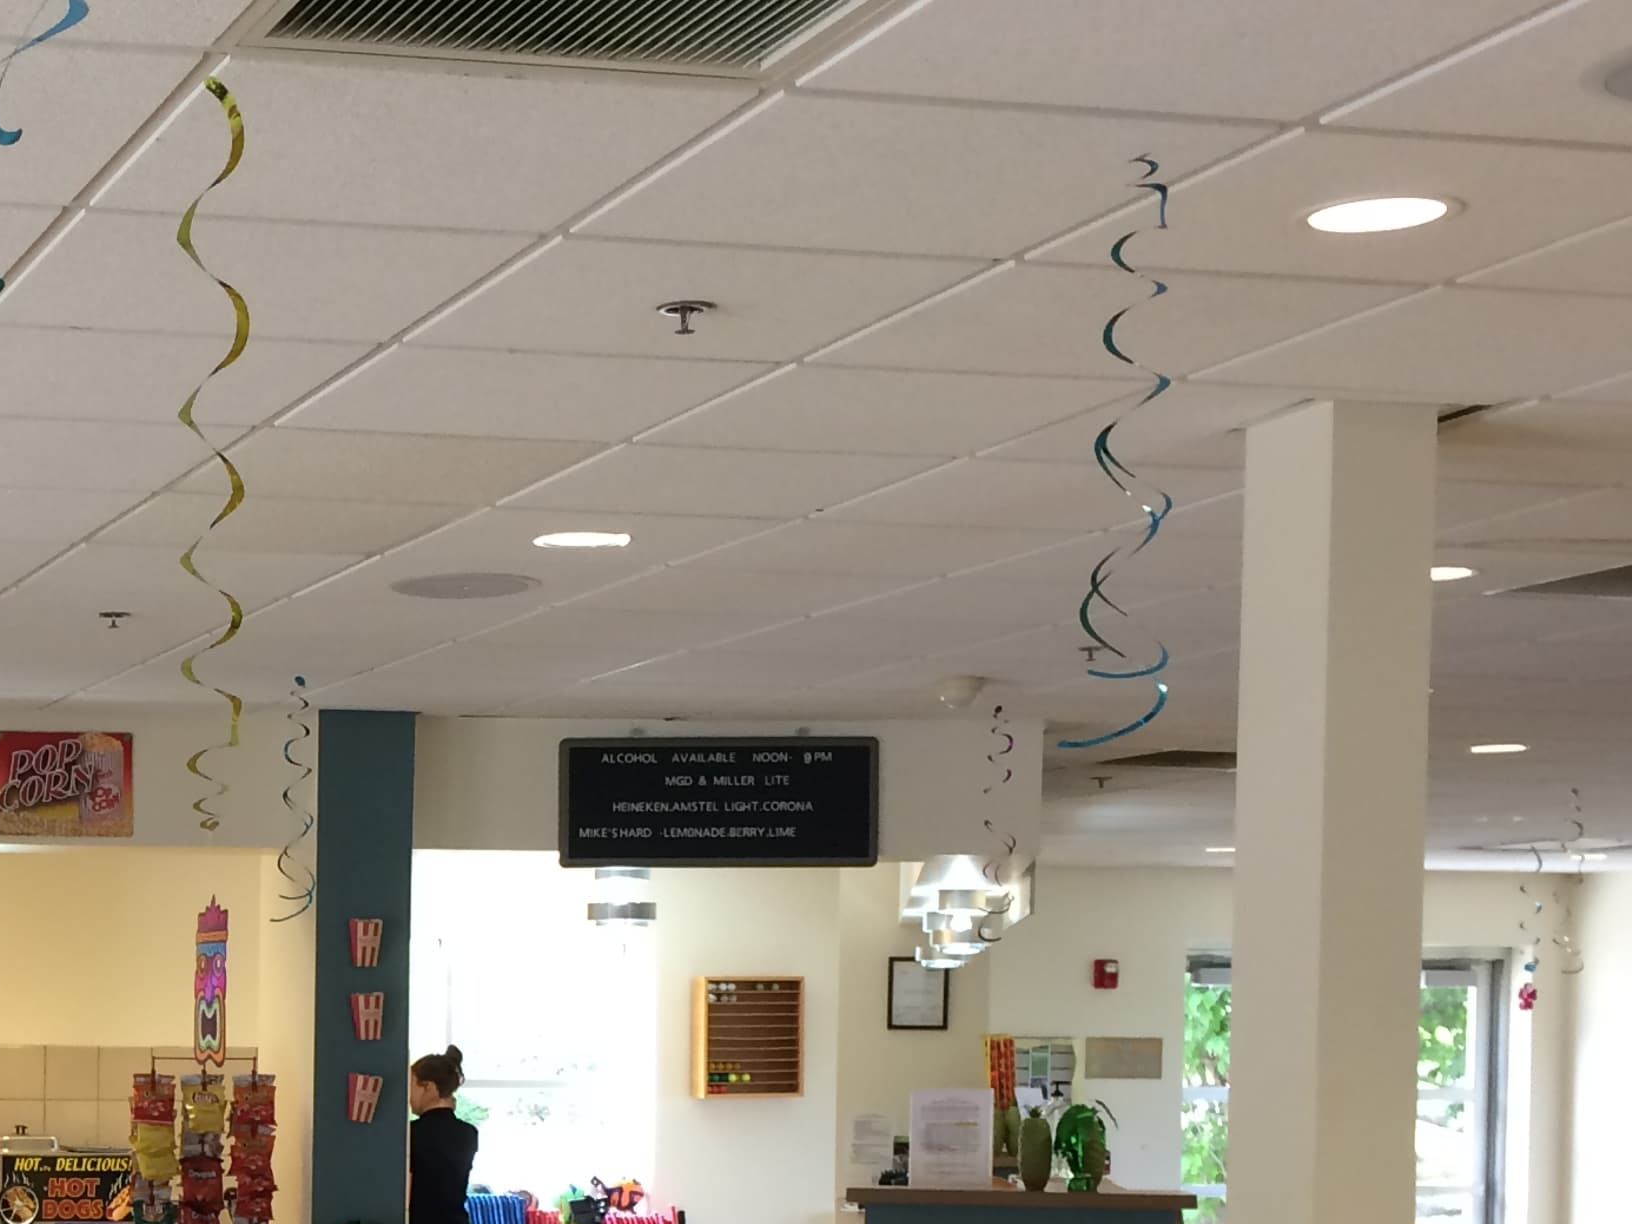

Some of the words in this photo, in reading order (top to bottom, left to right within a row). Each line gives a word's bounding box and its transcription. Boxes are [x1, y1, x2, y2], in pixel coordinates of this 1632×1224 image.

[9, 738, 82, 782] POP
[601, 753, 658, 764] ALCOHOL
[672, 752, 736, 763] AVAILABLE
[814, 752, 833, 762] PM
[664, 776, 693, 786] MGD
[698, 776, 707, 786] &
[713, 776, 755, 786] MILLER
[765, 775, 790, 786] LITE
[619, 827, 652, 838] HARD
[55, 1157, 132, 1172] DELICIOUS!
[47, 1177, 100, 1198] HOT
[42, 1199, 103, 1219] DOGS
